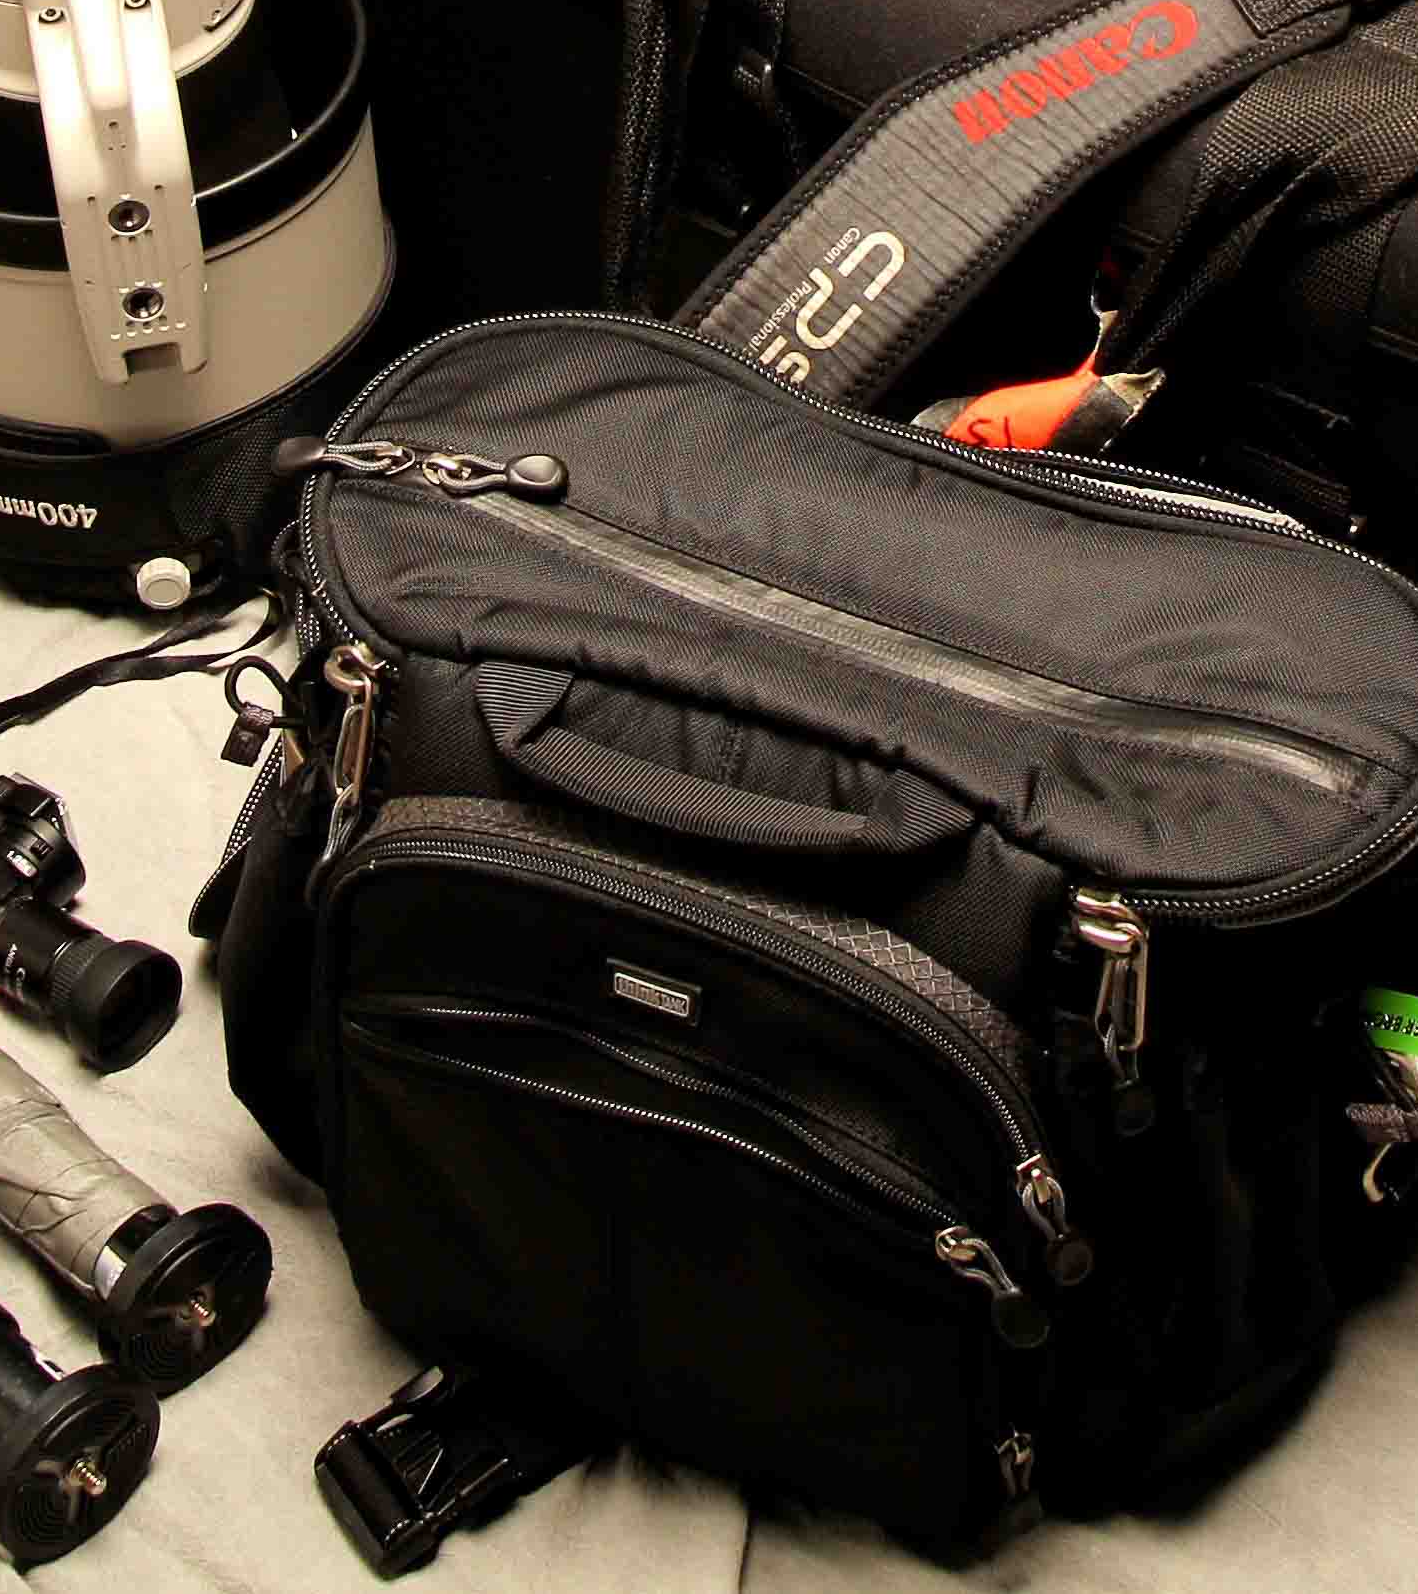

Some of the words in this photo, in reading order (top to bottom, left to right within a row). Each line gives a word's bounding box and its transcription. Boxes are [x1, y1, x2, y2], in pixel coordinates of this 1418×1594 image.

[952, 0, 1199, 146] Canon
[825, 226, 864, 266] Canon
[751, 279, 813, 351] Professional
